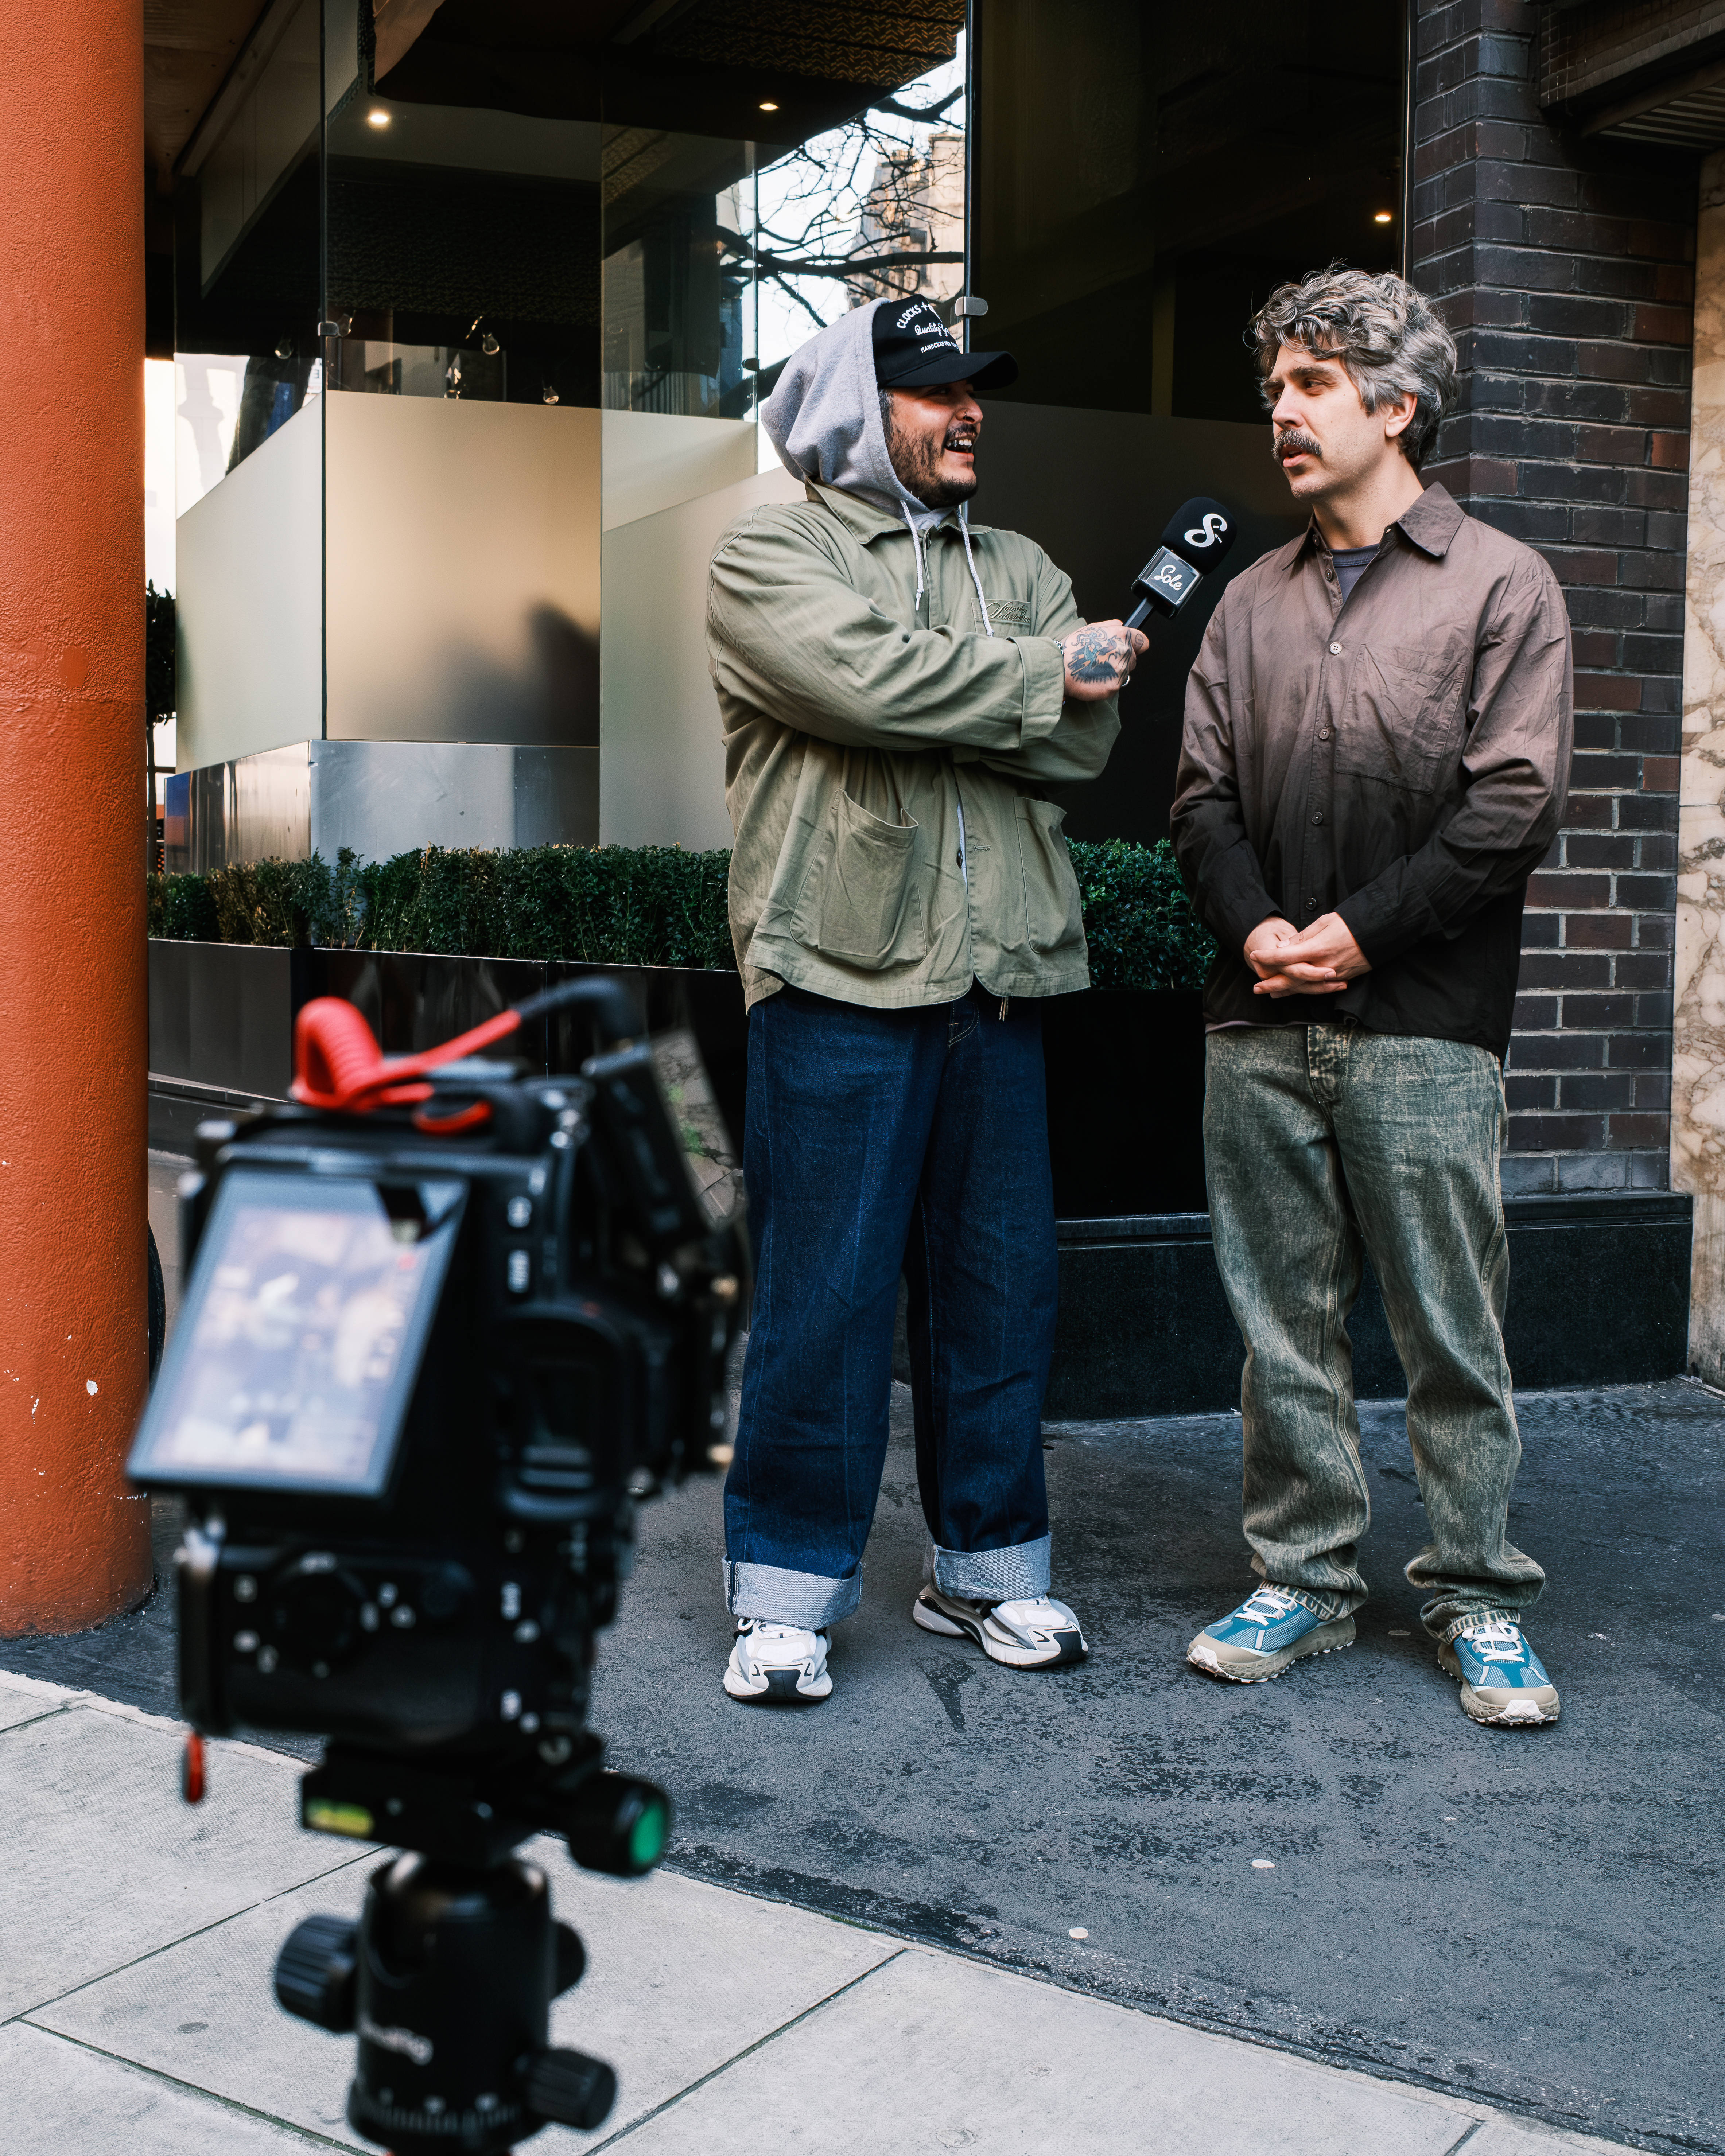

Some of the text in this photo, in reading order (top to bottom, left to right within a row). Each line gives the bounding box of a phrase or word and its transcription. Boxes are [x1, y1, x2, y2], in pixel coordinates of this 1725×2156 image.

[896, 305, 922, 328] CLOCKS
[921, 301, 928, 311] +
[914, 322, 942, 337] Quality
[1154, 565, 1182, 591] Sole
